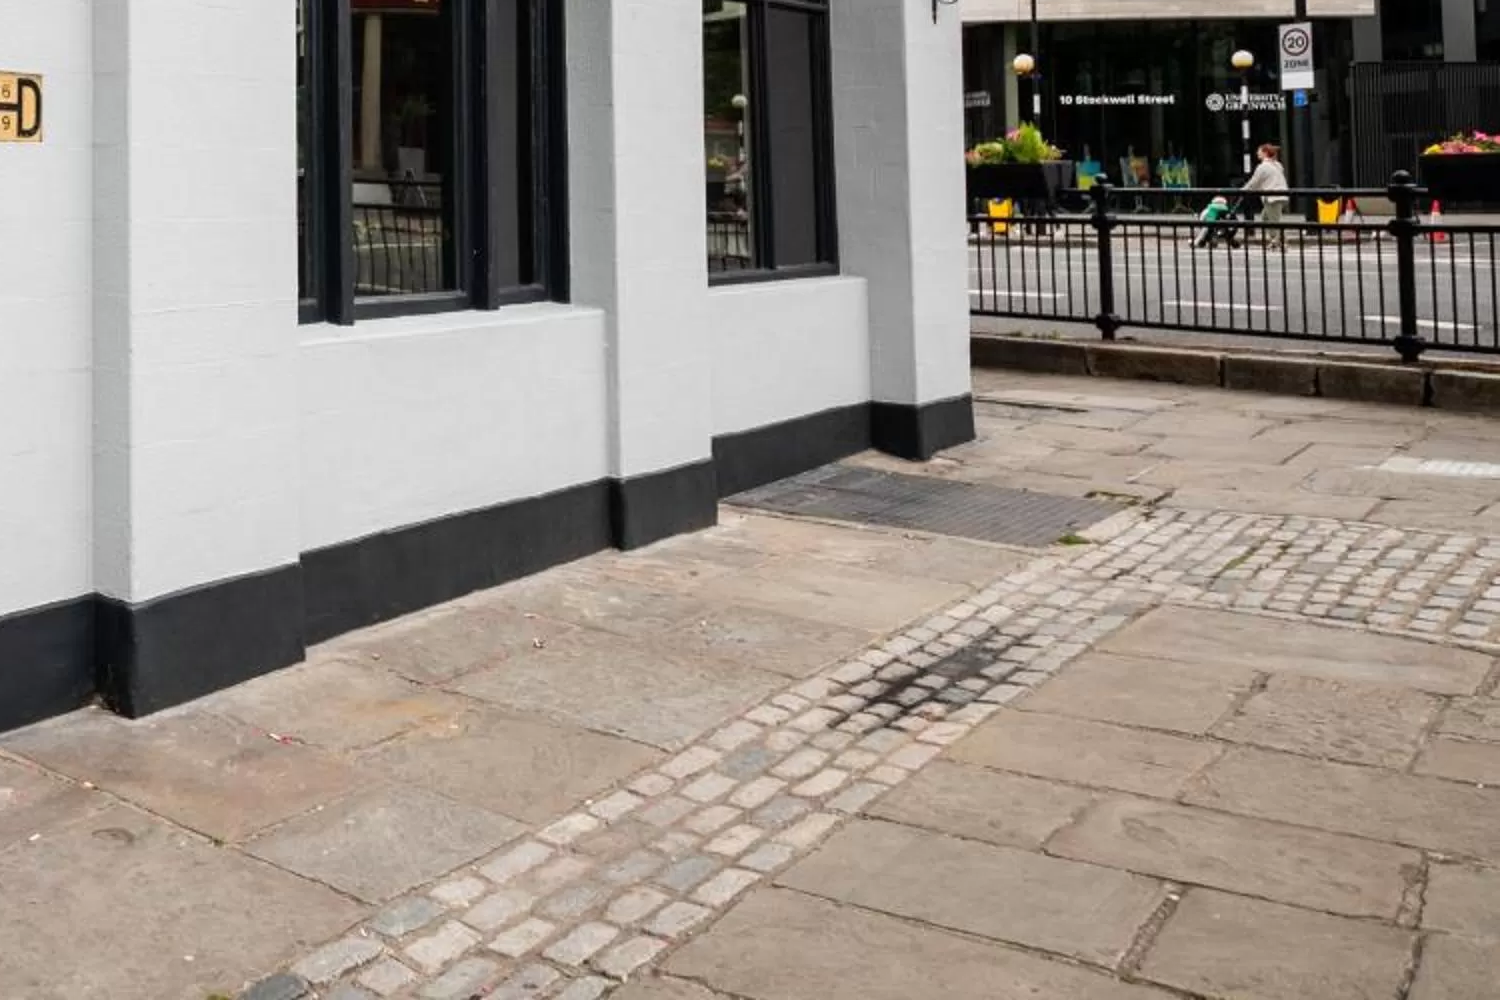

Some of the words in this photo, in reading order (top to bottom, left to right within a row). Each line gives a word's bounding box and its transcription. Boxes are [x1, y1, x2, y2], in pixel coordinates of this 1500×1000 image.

[1287, 35, 1305, 49] 20
[1060, 94, 1073, 105] 10
[1075, 93, 1135, 105] Stockwell
[1137, 94, 1175, 105] Street
